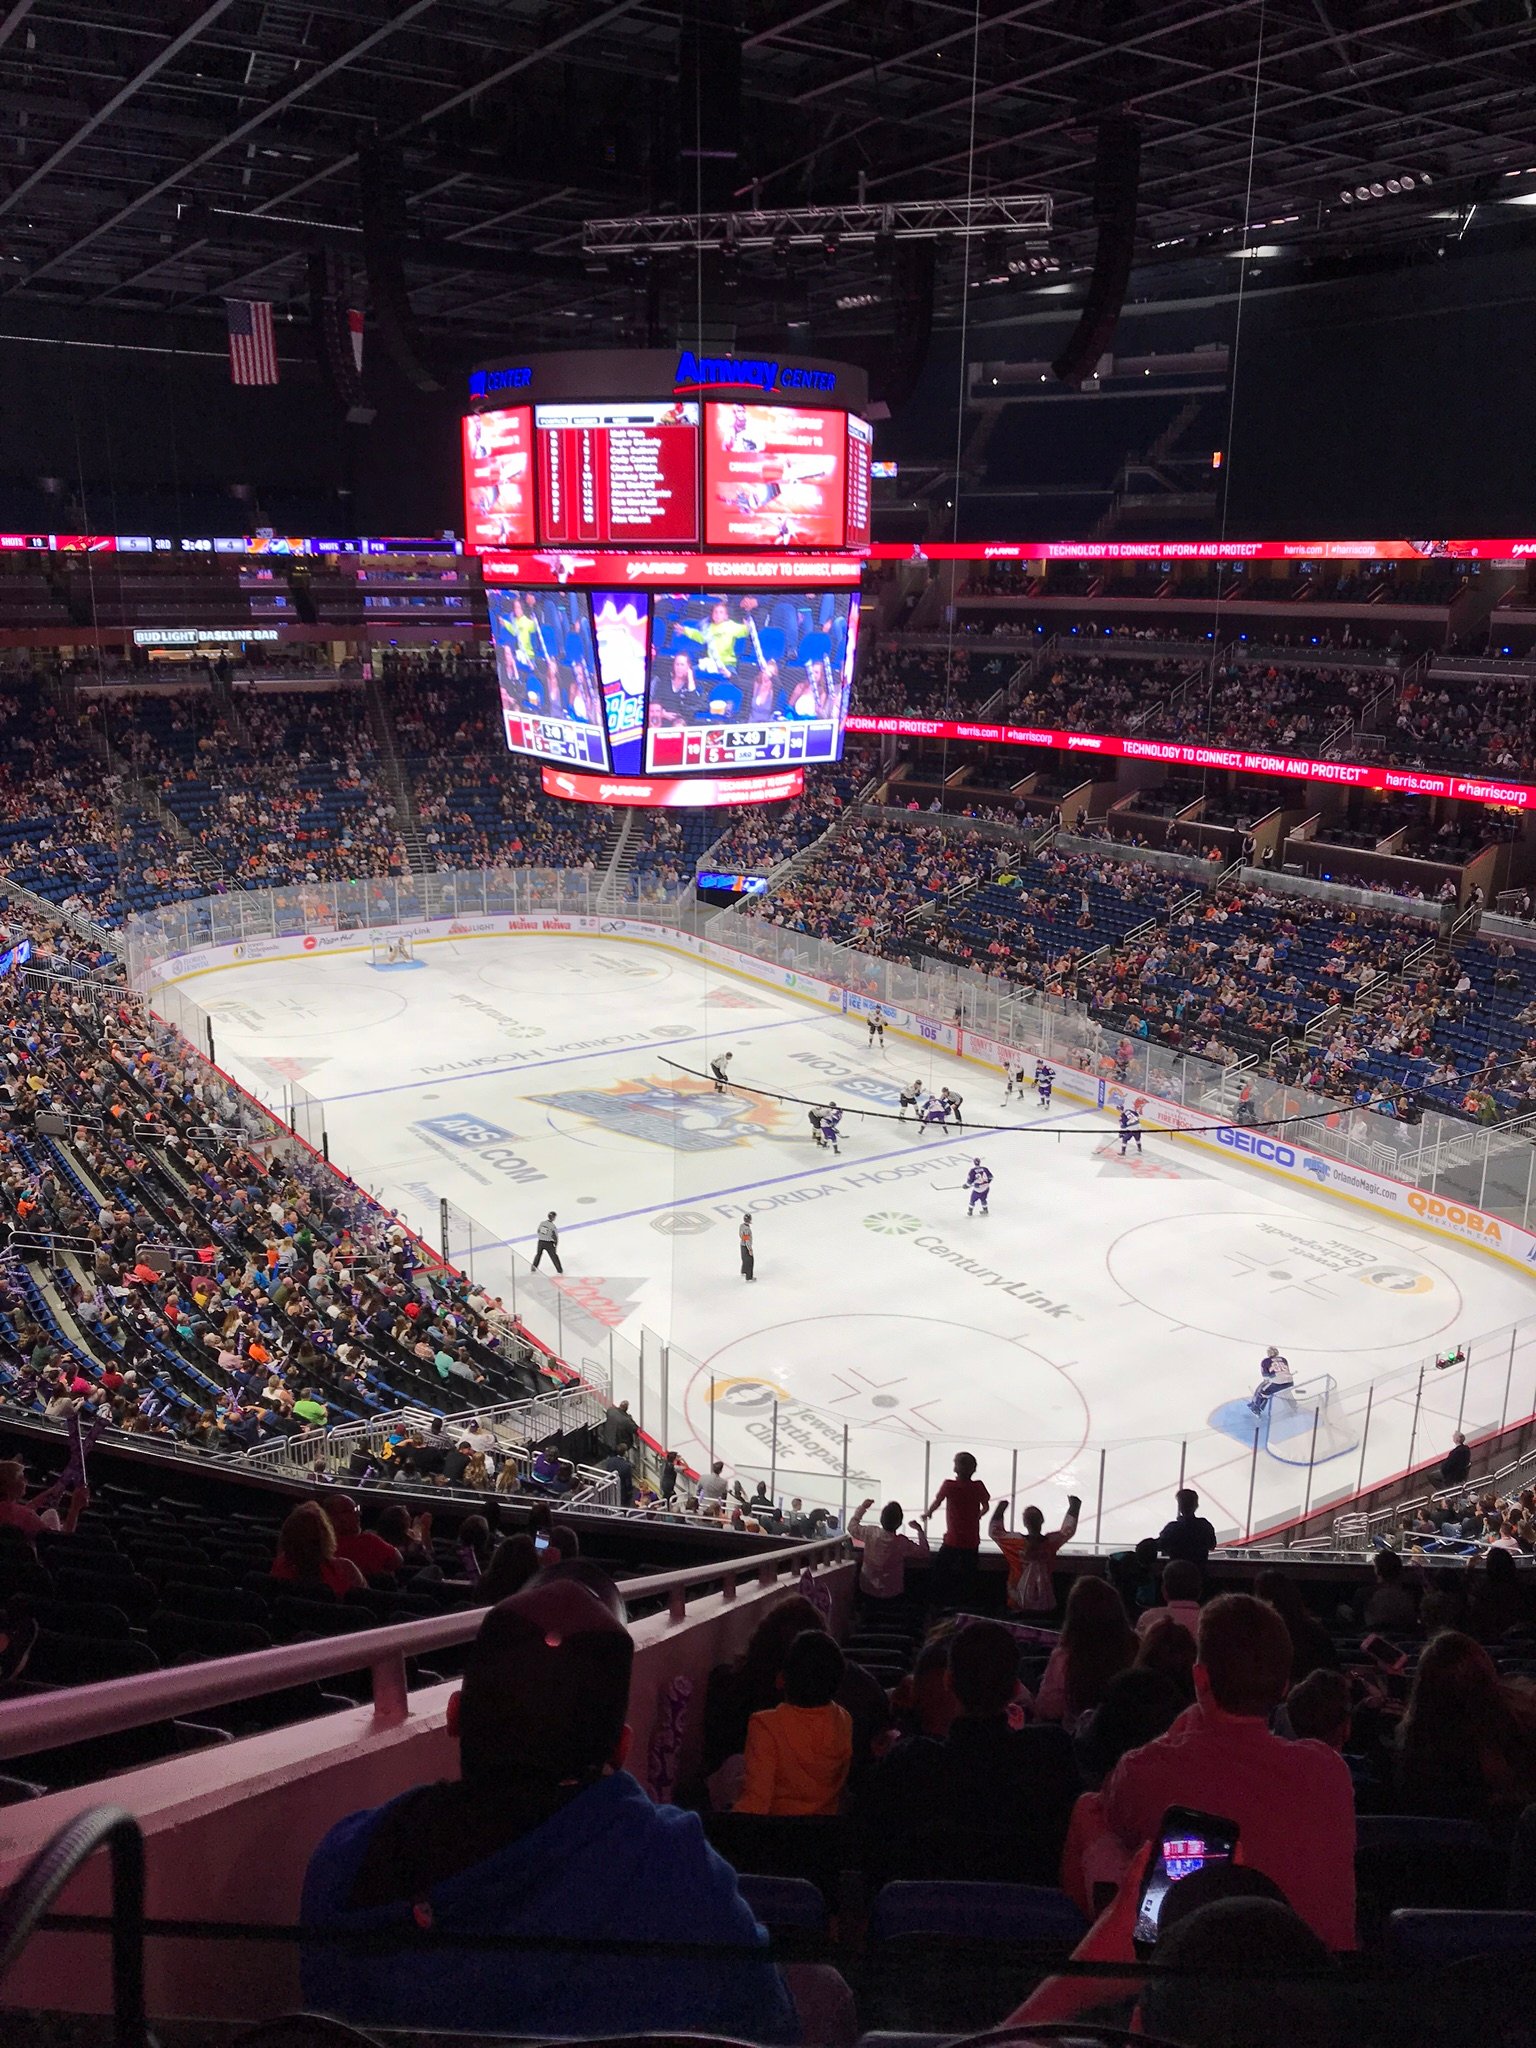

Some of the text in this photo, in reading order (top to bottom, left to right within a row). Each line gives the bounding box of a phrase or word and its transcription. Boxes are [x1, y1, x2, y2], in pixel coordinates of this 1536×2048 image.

[486, 367, 533, 391] CENTER
[675, 351, 837, 392] Amway CENTER
[1, 537, 43, 547] SHOTS 19
[129, 539, 137, 548] 5
[155, 539, 212, 551] 3RD 3:49
[226, 541, 234, 550] 4
[318, 542, 339, 551] SHOTS
[371, 541, 385, 551] PEN
[1048, 544, 1106, 556] TECHNOLOGY
[1107, 544, 1119, 556] TO
[1120, 544, 1161, 557] CONNECT,
[1162, 544, 1197, 556] INFORM
[1198, 544, 1218, 555] AND
[1284, 545, 1376, 556] harris.com #harriscorp
[984, 547, 1020, 558] HARRIS
[706, 562, 778, 576] TECHNOLOGY
[779, 562, 792, 576] TO
[136, 629, 279, 643] BUD LIGHT BASELINE BAR
[876, 719, 898, 731] AND
[731, 731, 761, 746] 3:49
[956, 725, 1053, 744] harris.com #harriscorp
[1067, 736, 1102, 750] HARRIS
[708, 747, 720, 763] 5
[770, 744, 781, 758] 4
[1122, 740, 1181, 760] TECHNOLOGY
[1182, 747, 1195, 761] TO
[1196, 748, 1242, 769] CONNECT,
[1244, 754, 1284, 771] INFORM
[1285, 758, 1310, 774] AND
[1385, 772, 1528, 805] harris.com #harriscorp
[472, 923, 494, 932] LIGHT
[508, 920, 538, 931] Wawa
[542, 920, 572, 931] Wawa
[919, 1025, 937, 1041] 105
[547, 1032, 650, 1053] FLORIDA
[412, 1049, 545, 1075] HOSPITAL
[432, 1119, 501, 1142] ARS
[1216, 1126, 1295, 1168] GEICO
[713, 1152, 985, 1220] FLORIDA HOSPITAL
[1332, 1168, 1397, 1201] OrlandoMagic.com
[1407, 1191, 1503, 1242] QDOBA
[1426, 1214, 1502, 1247] MEXICAN EATS
[1255, 1222, 1364, 1269] Orthopaedic
[1326, 1239, 1379, 1263] Clinic
[1288, 1245, 1350, 1273] Jewett
[913, 1236, 1073, 1320] CenturyLink
[787, 1407, 853, 1446] Jewett
[744, 1421, 796, 1459] Clinic
[769, 1414, 875, 1490] Orthopaedic
